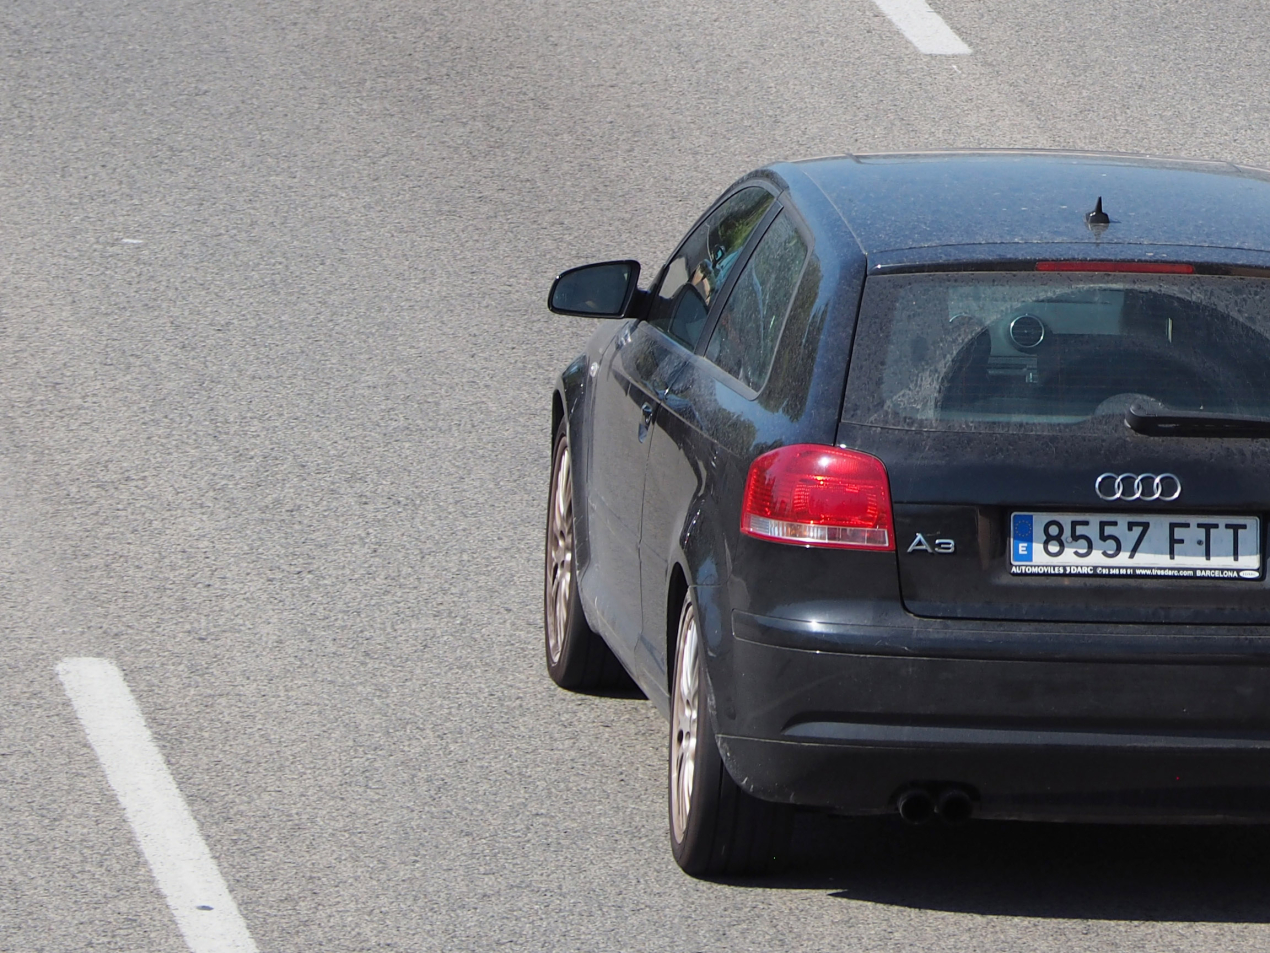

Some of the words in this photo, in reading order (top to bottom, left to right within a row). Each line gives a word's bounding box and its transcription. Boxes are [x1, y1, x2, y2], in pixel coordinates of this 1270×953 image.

[906, 532, 955, 554] A3
[1018, 543, 1028, 555] E
[1042, 519, 1151, 559] 8557
[1168, 522, 1248, 562] FTT
[1010, 566, 1064, 574] AUTOMOVILES
[1195, 569, 1239, 578] BARCELONA
